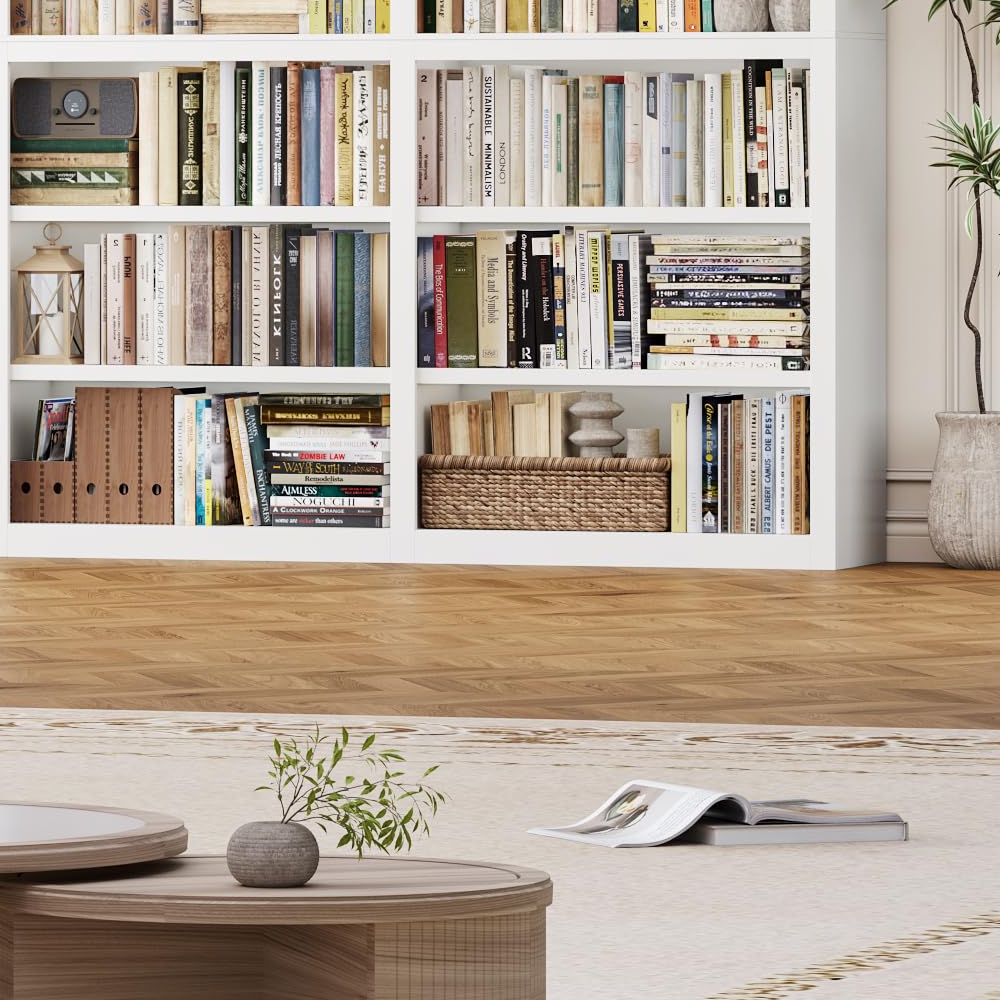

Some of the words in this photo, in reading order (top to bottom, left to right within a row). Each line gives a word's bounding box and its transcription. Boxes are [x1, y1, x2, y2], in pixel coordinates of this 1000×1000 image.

[274, 83, 282, 123] КРЕПОСТЬ
[484, 76, 492, 135] SUSTAINABLE
[274, 126, 282, 160] ЛЕСНАЯ
[484, 143, 492, 197] MINIMALISM
[487, 257, 498, 276] Media
[592, 267, 600, 293] worlds
[487, 279, 497, 293] and
[436, 293, 444, 334] Communication
[485, 296, 498, 324] Symbols
[765, 412, 773, 435] PEST
[256, 469, 270, 523] ENCHANTRESS
[281, 485, 317, 495] AIMLESS
[293, 497, 355, 506] NOGUCHI
